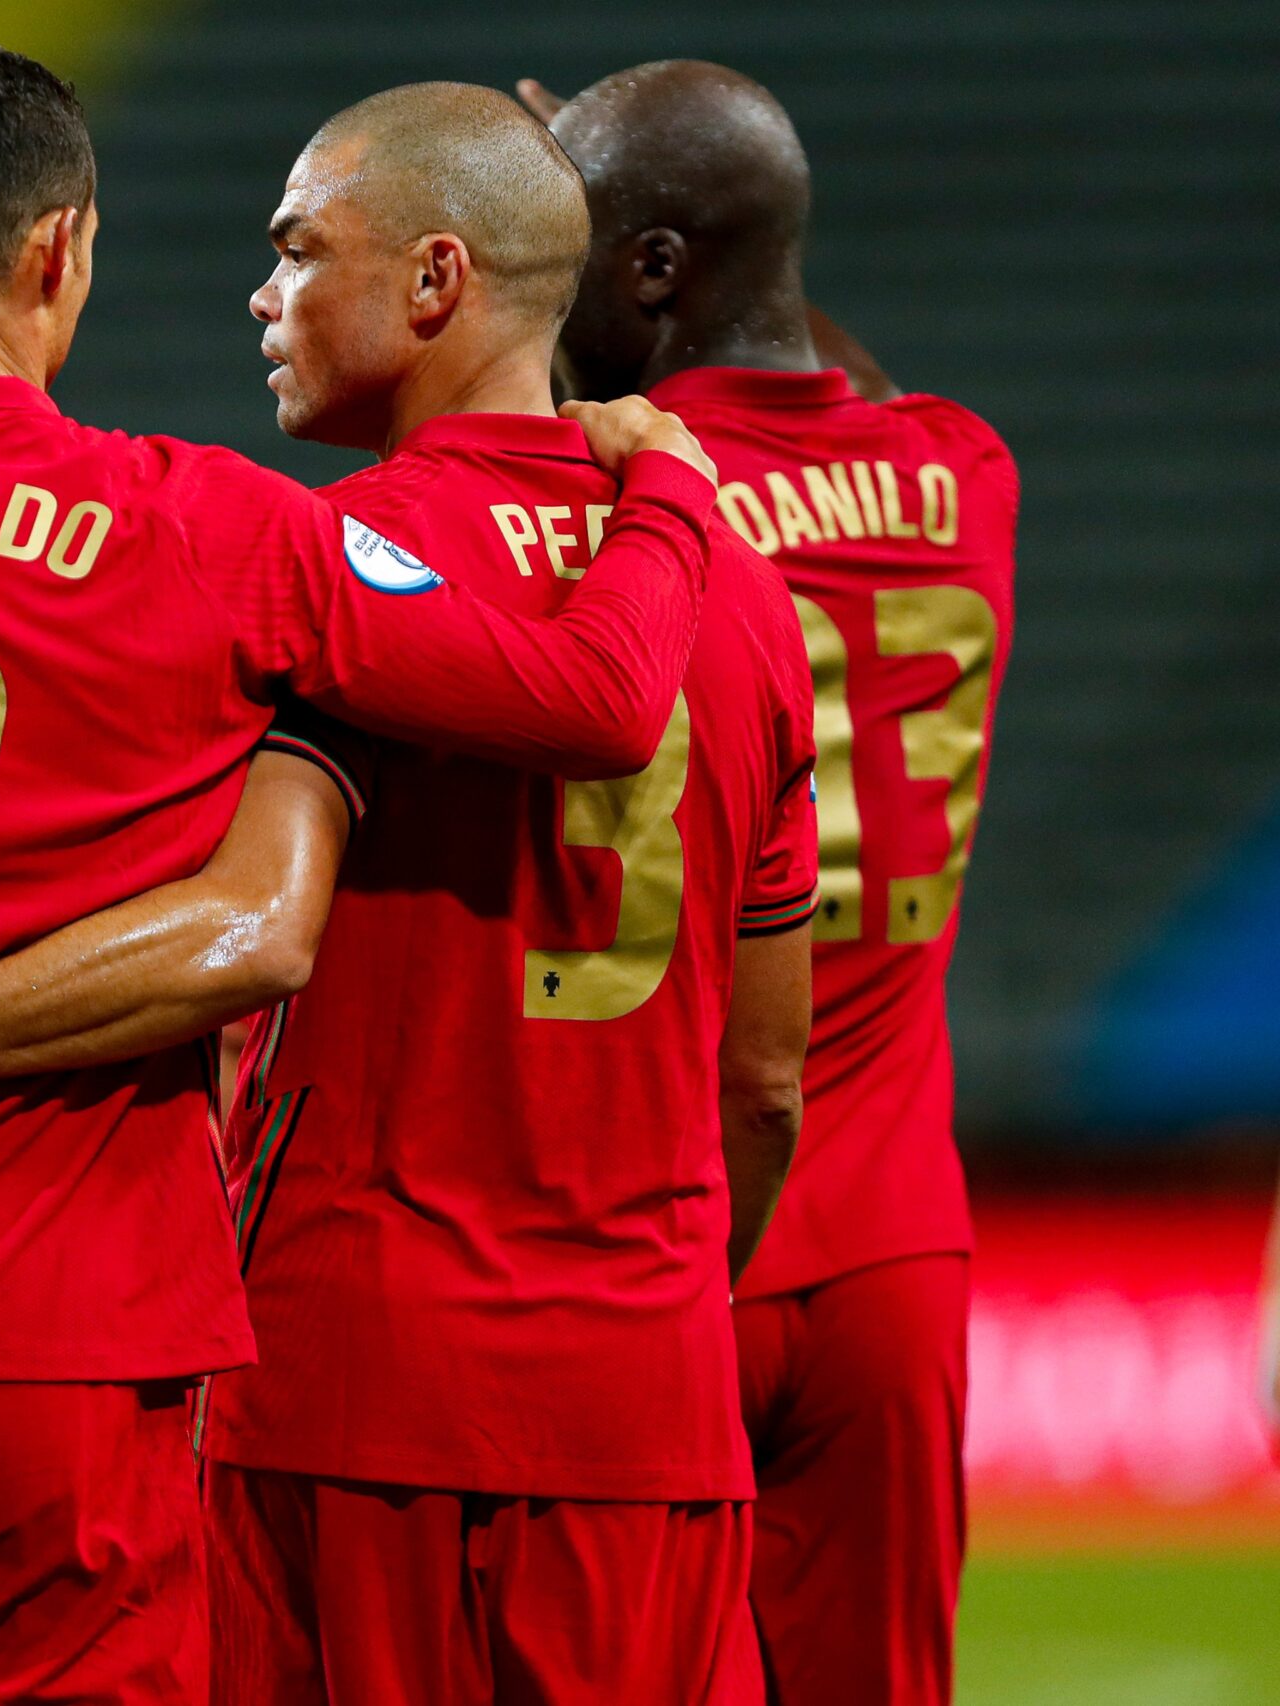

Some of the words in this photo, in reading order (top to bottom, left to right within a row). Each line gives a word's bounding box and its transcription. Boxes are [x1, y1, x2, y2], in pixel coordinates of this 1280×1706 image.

[717, 460, 958, 557] DANILO
[523, 687, 691, 1021] 3
[792, 585, 996, 944] 13
